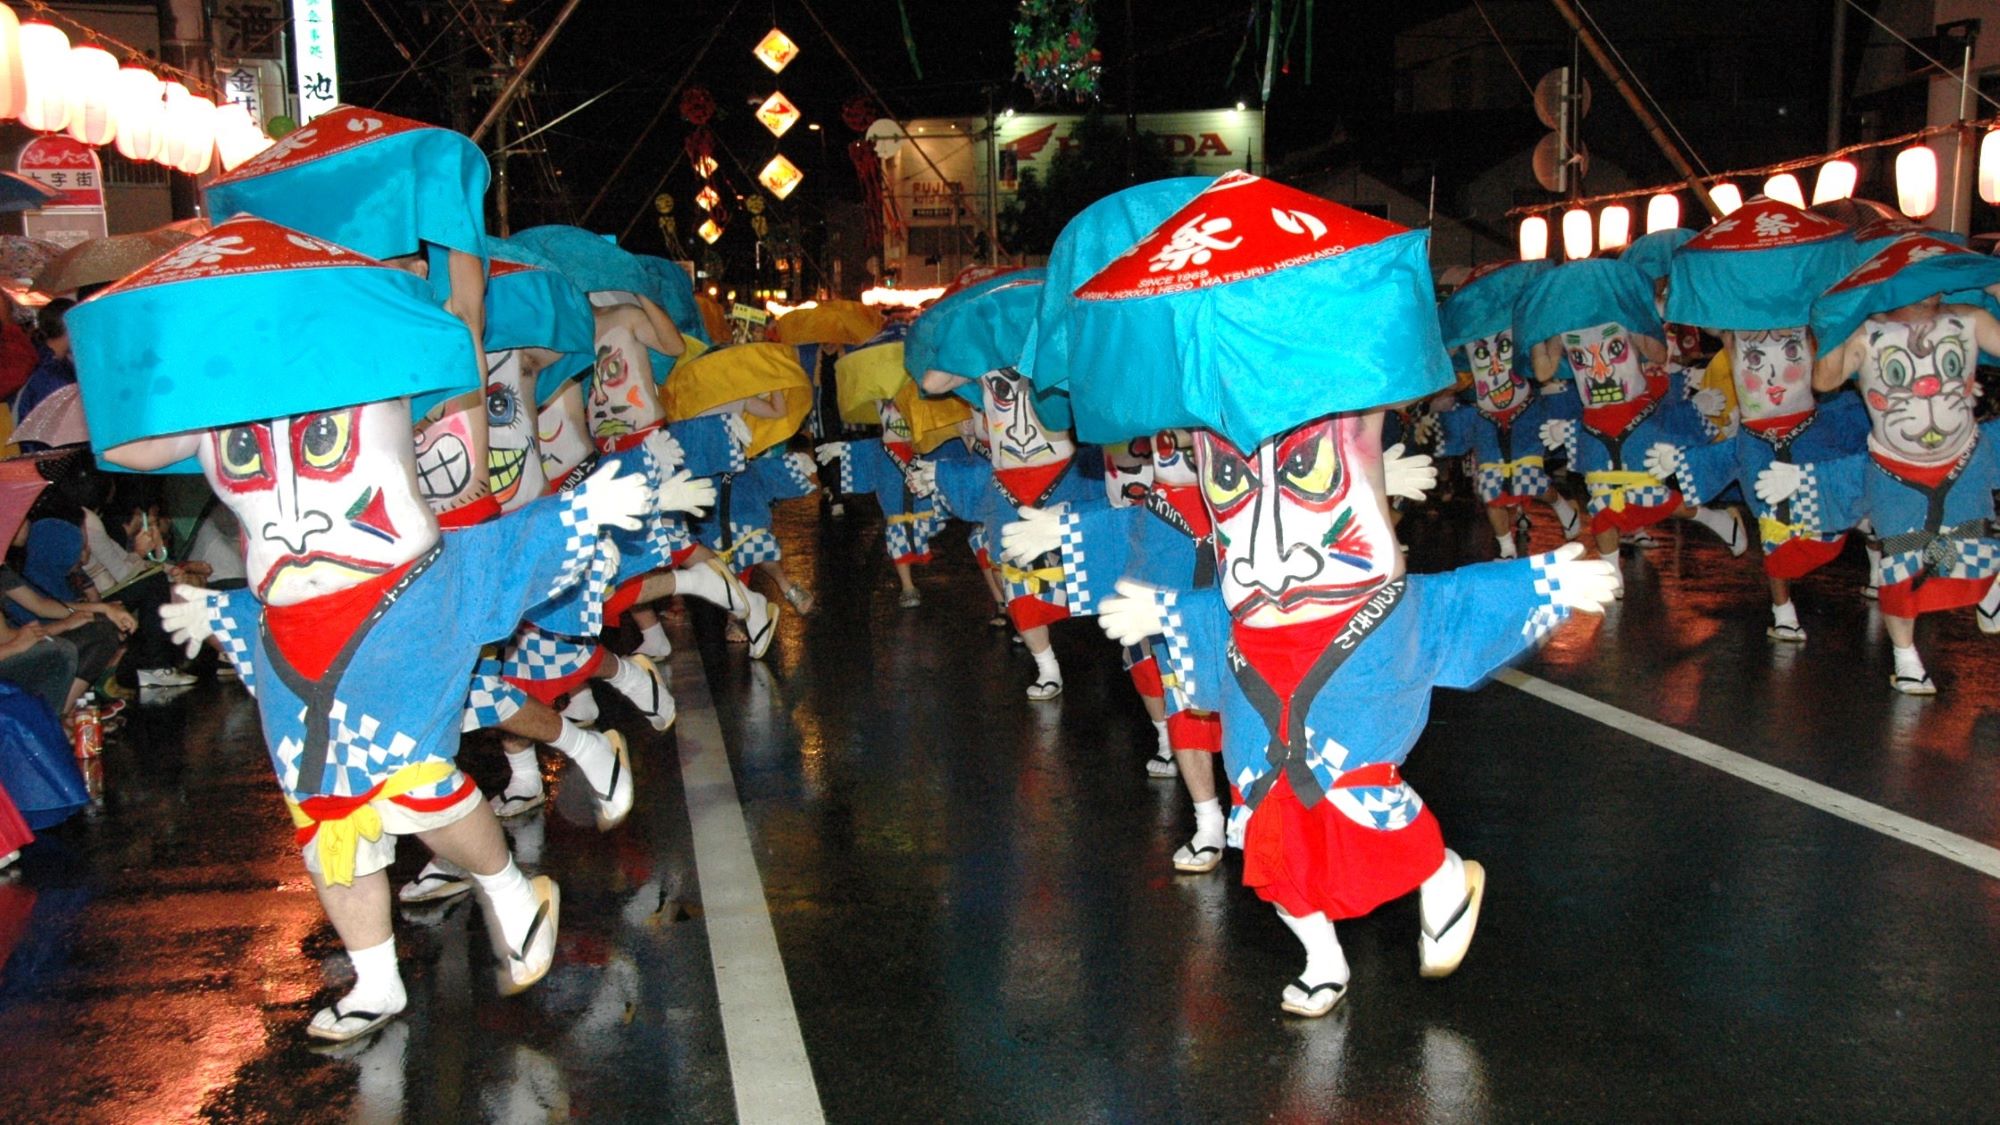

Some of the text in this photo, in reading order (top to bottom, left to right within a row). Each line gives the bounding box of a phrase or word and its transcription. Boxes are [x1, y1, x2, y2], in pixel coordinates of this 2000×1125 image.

[1137, 269, 1210, 289] SINCE 1969
[1156, 281, 1195, 295] HESO
[1200, 266, 1265, 288] MATSURI
[1273, 244, 1346, 271] HOKKAIDO
